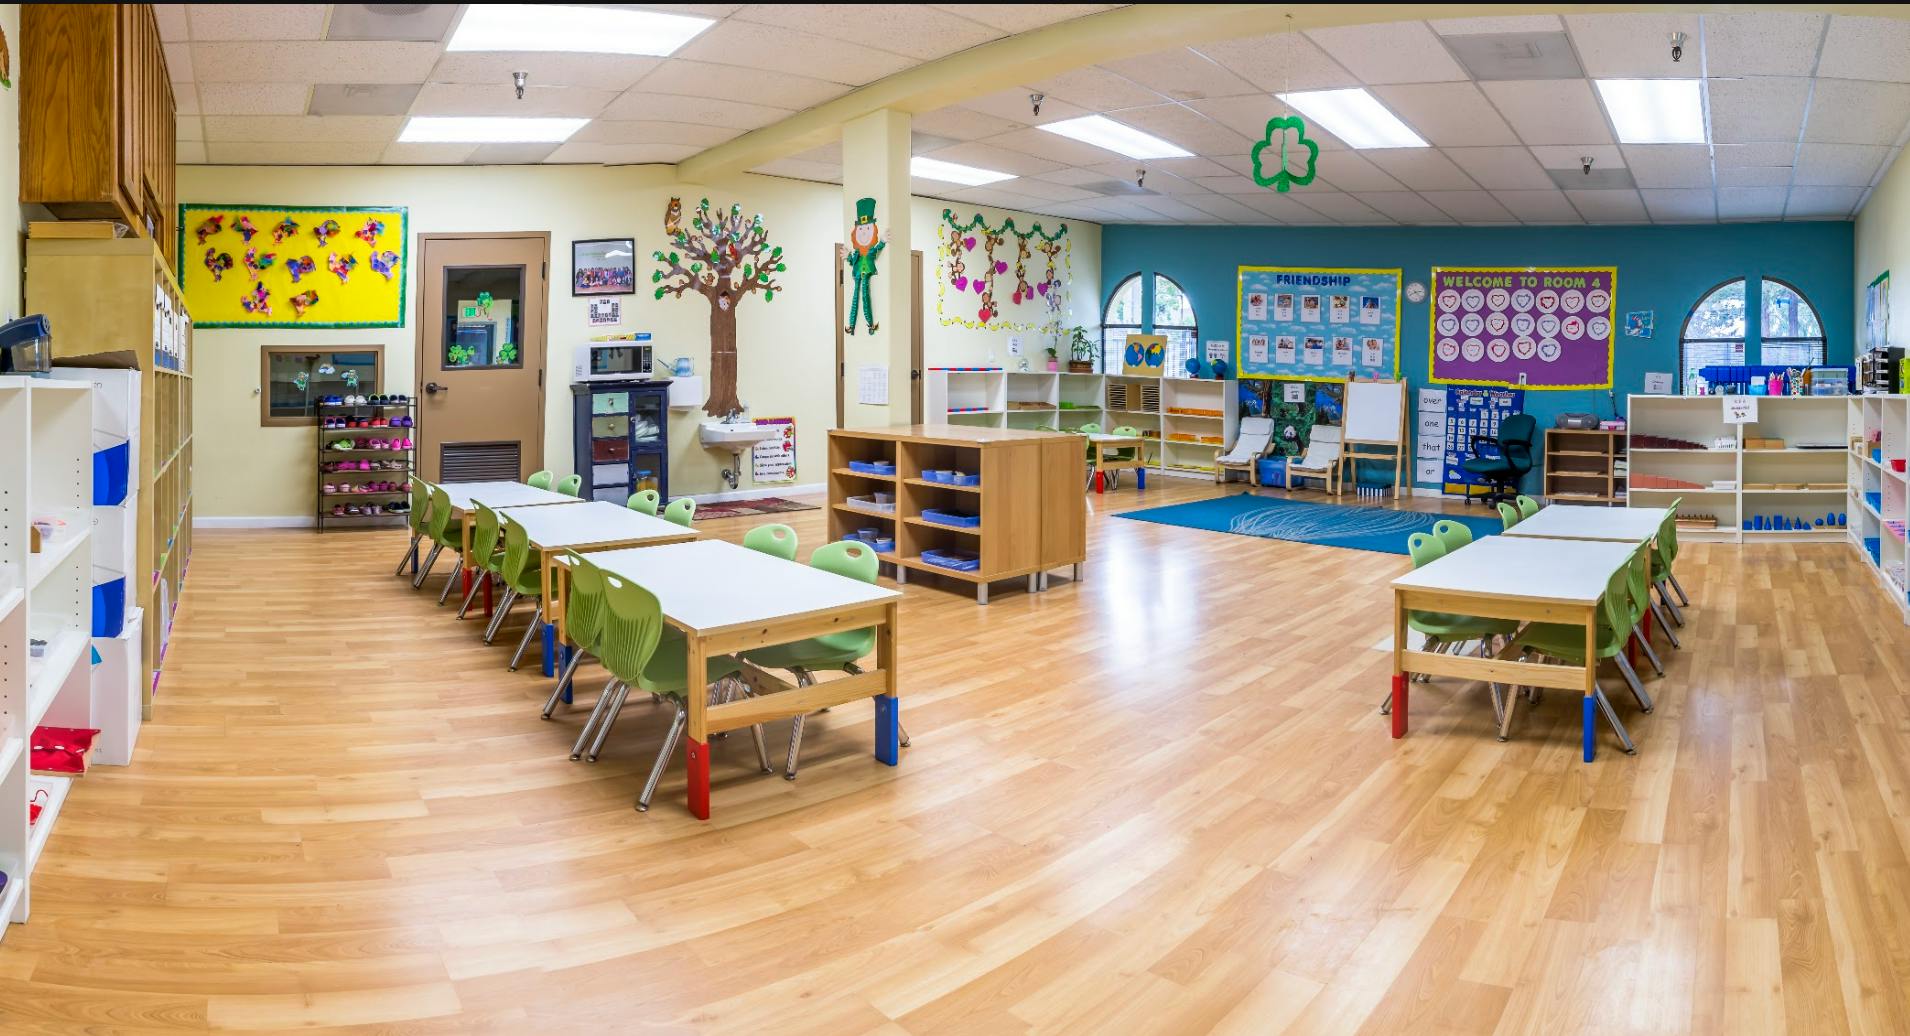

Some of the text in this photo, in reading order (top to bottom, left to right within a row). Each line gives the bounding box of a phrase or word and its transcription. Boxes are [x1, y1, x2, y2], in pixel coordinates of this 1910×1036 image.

[1276, 274, 1351, 287] FRIENDSHIP
[1443, 276, 1600, 288] WELCOME TO ROOM 4
[1422, 442, 1441, 451] that
